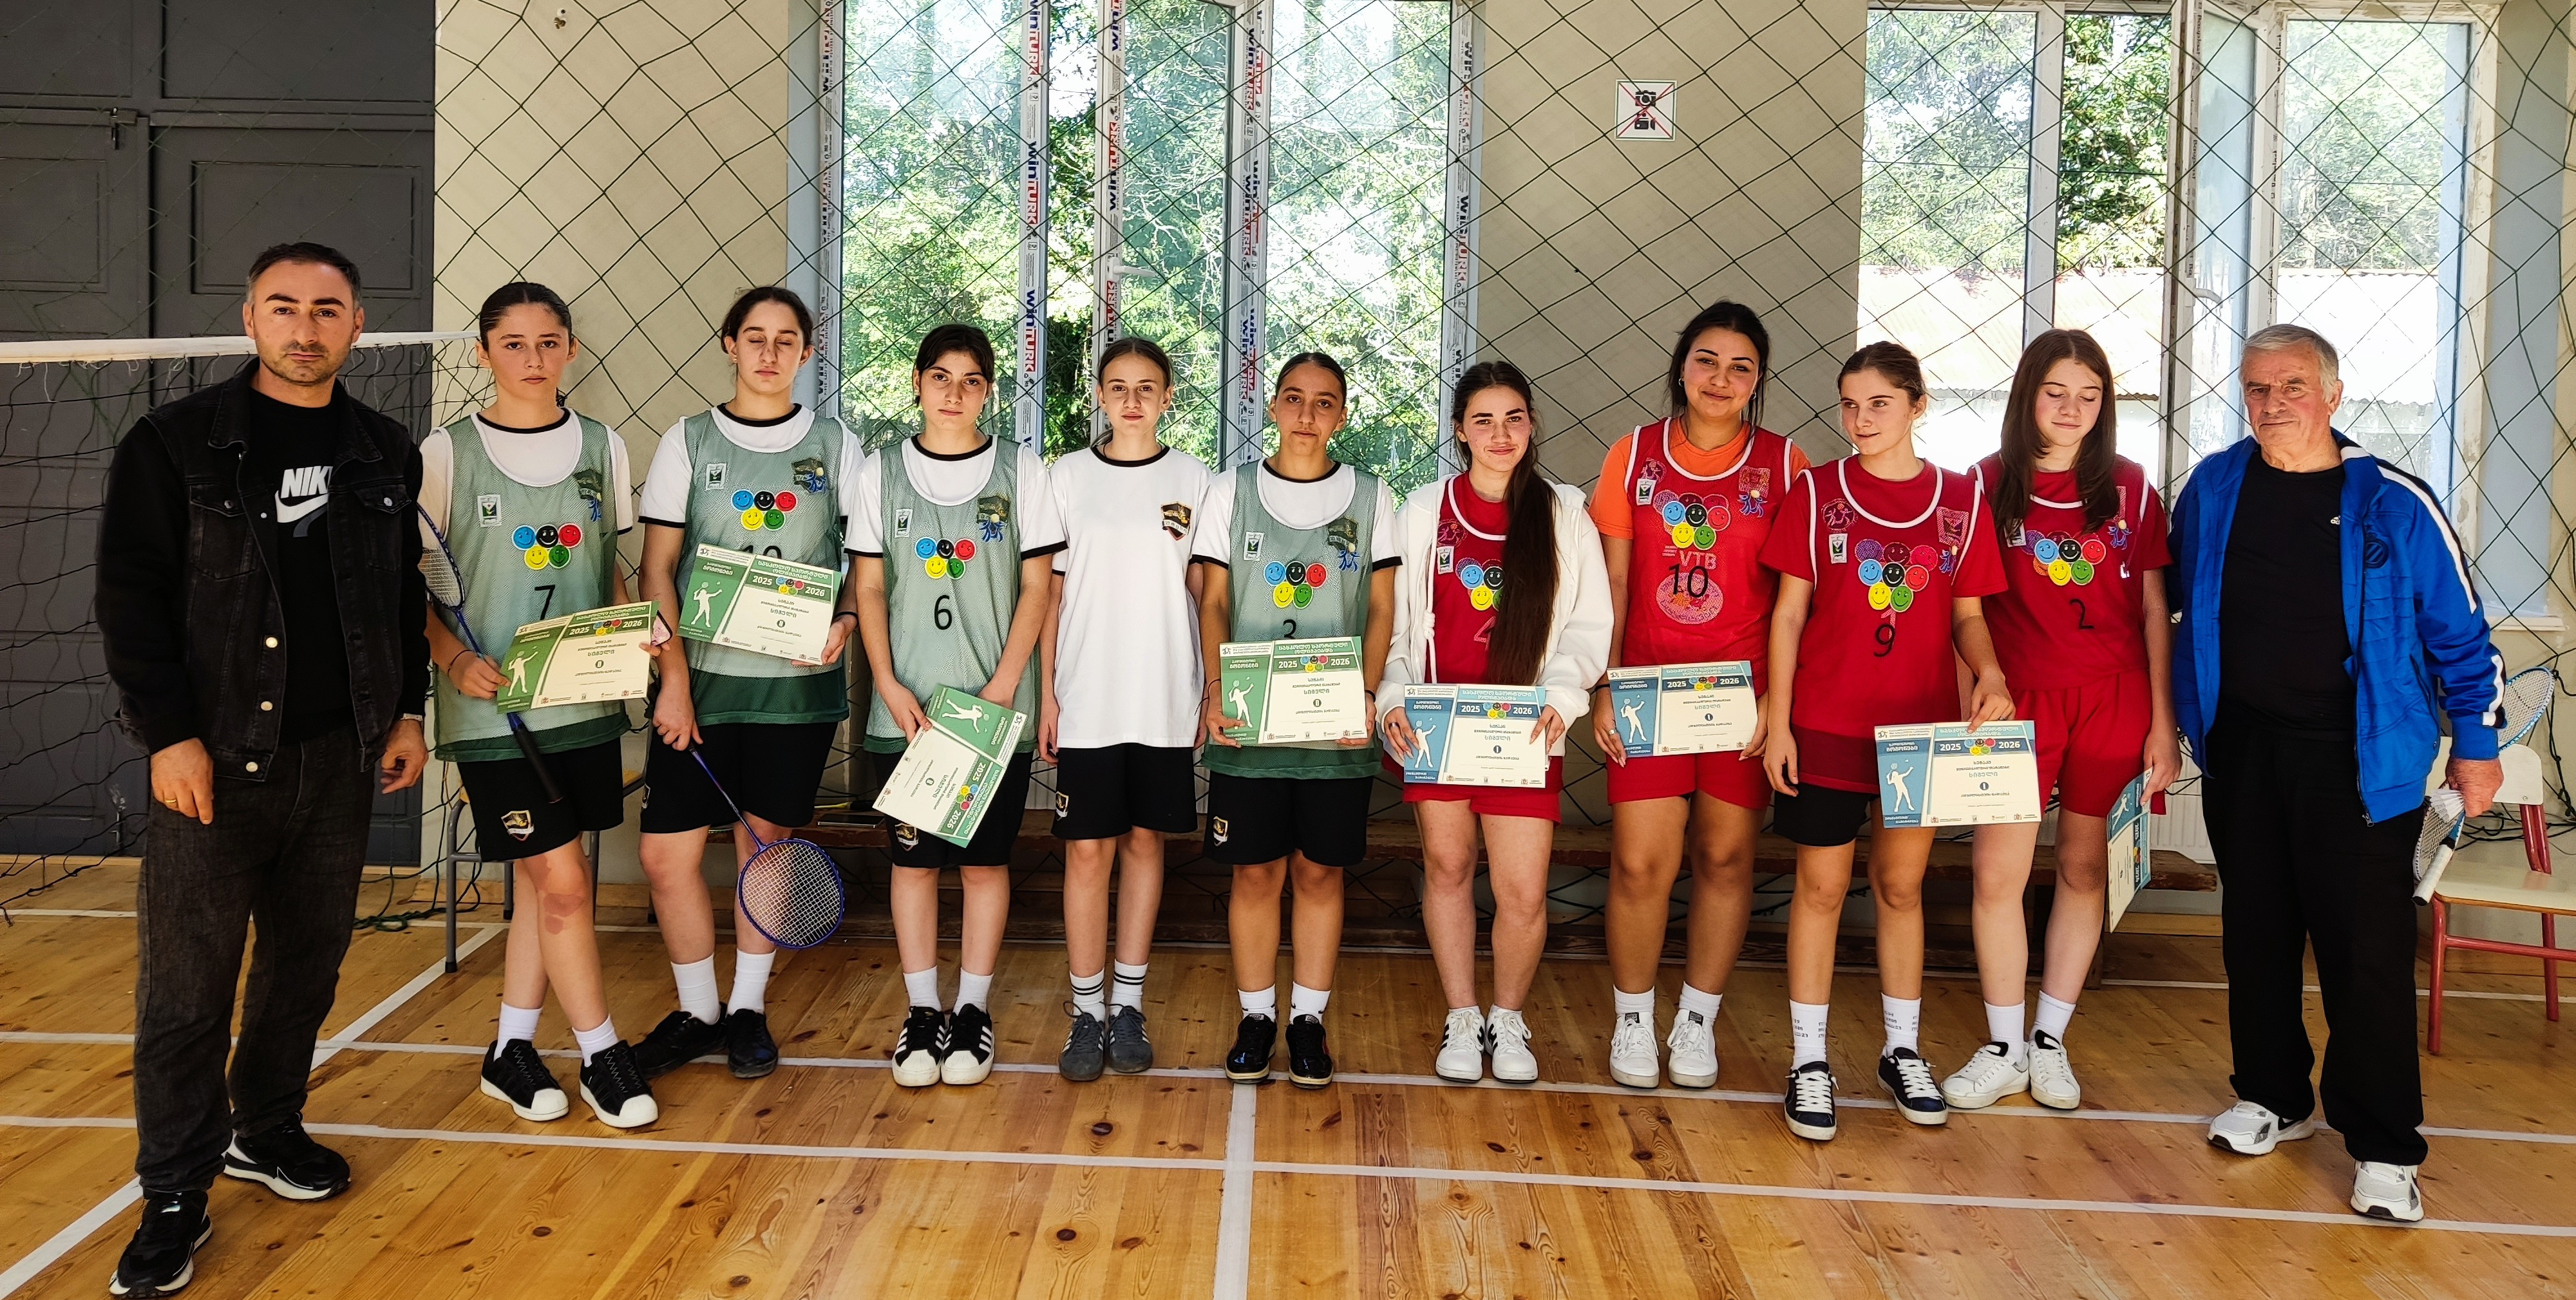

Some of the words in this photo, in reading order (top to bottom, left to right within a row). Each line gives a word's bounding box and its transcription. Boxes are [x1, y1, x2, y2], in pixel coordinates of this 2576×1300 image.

[1106, 281, 1116, 348] inTURK
[1025, 289, 1037, 373] winTURK
[281, 466, 333, 498] NIK
[1679, 550, 1718, 569] VTB
[752, 576, 773, 586] 2025
[805, 586, 826, 596] 2026
[1668, 563, 1709, 598] 10
[534, 585, 556, 619] 7
[934, 594, 951, 630] 6
[2069, 598, 2095, 630] 2
[569, 626, 590, 636] 2025
[1873, 623, 1895, 657] 9
[1278, 660, 1298, 668] 2025
[1461, 705, 1481, 713] 2025
[1940, 743, 1962, 751] 2025
[1998, 740, 2021, 749] 2026
[972, 762, 987, 782] 2025
[946, 809, 961, 830] 2026
